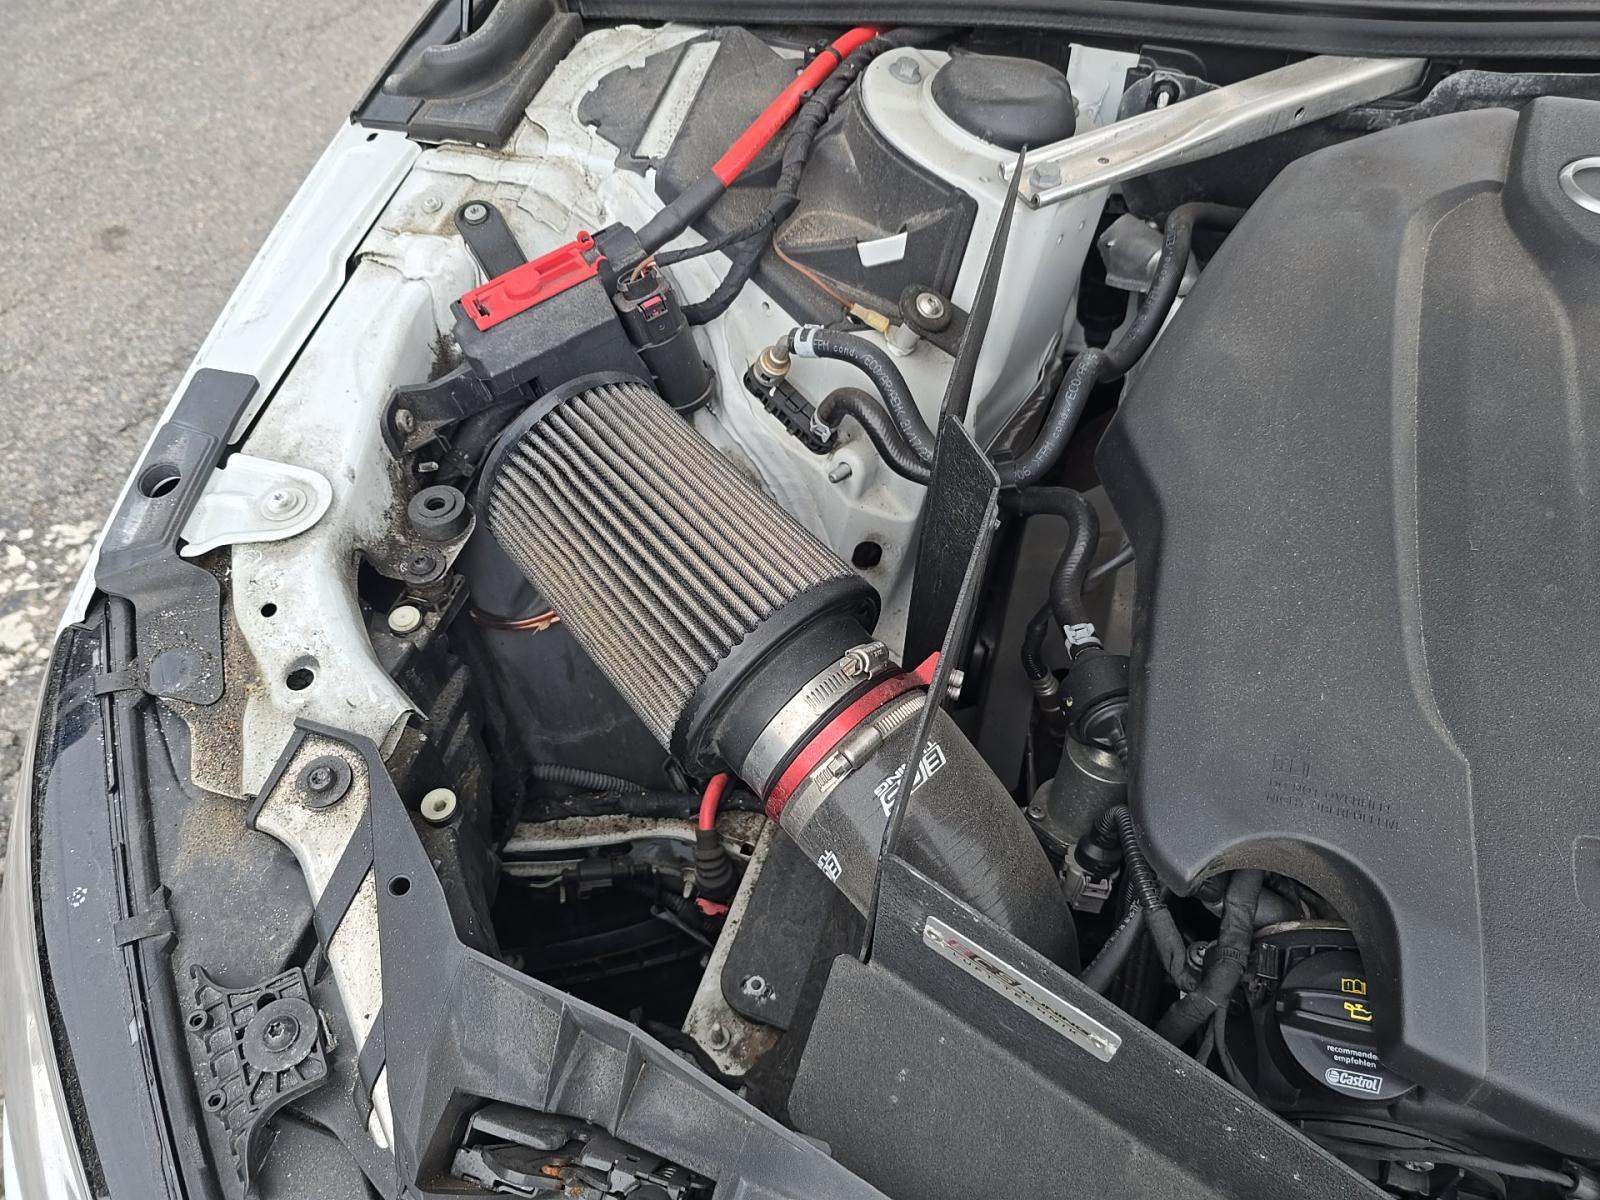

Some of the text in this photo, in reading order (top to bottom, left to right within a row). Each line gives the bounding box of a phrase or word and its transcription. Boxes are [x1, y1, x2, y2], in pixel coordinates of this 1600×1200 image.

[1327, 1045, 1379, 1061] recommende
[1334, 1055, 1377, 1069] empfohlen
[1340, 1073, 1377, 1091] Castrol
